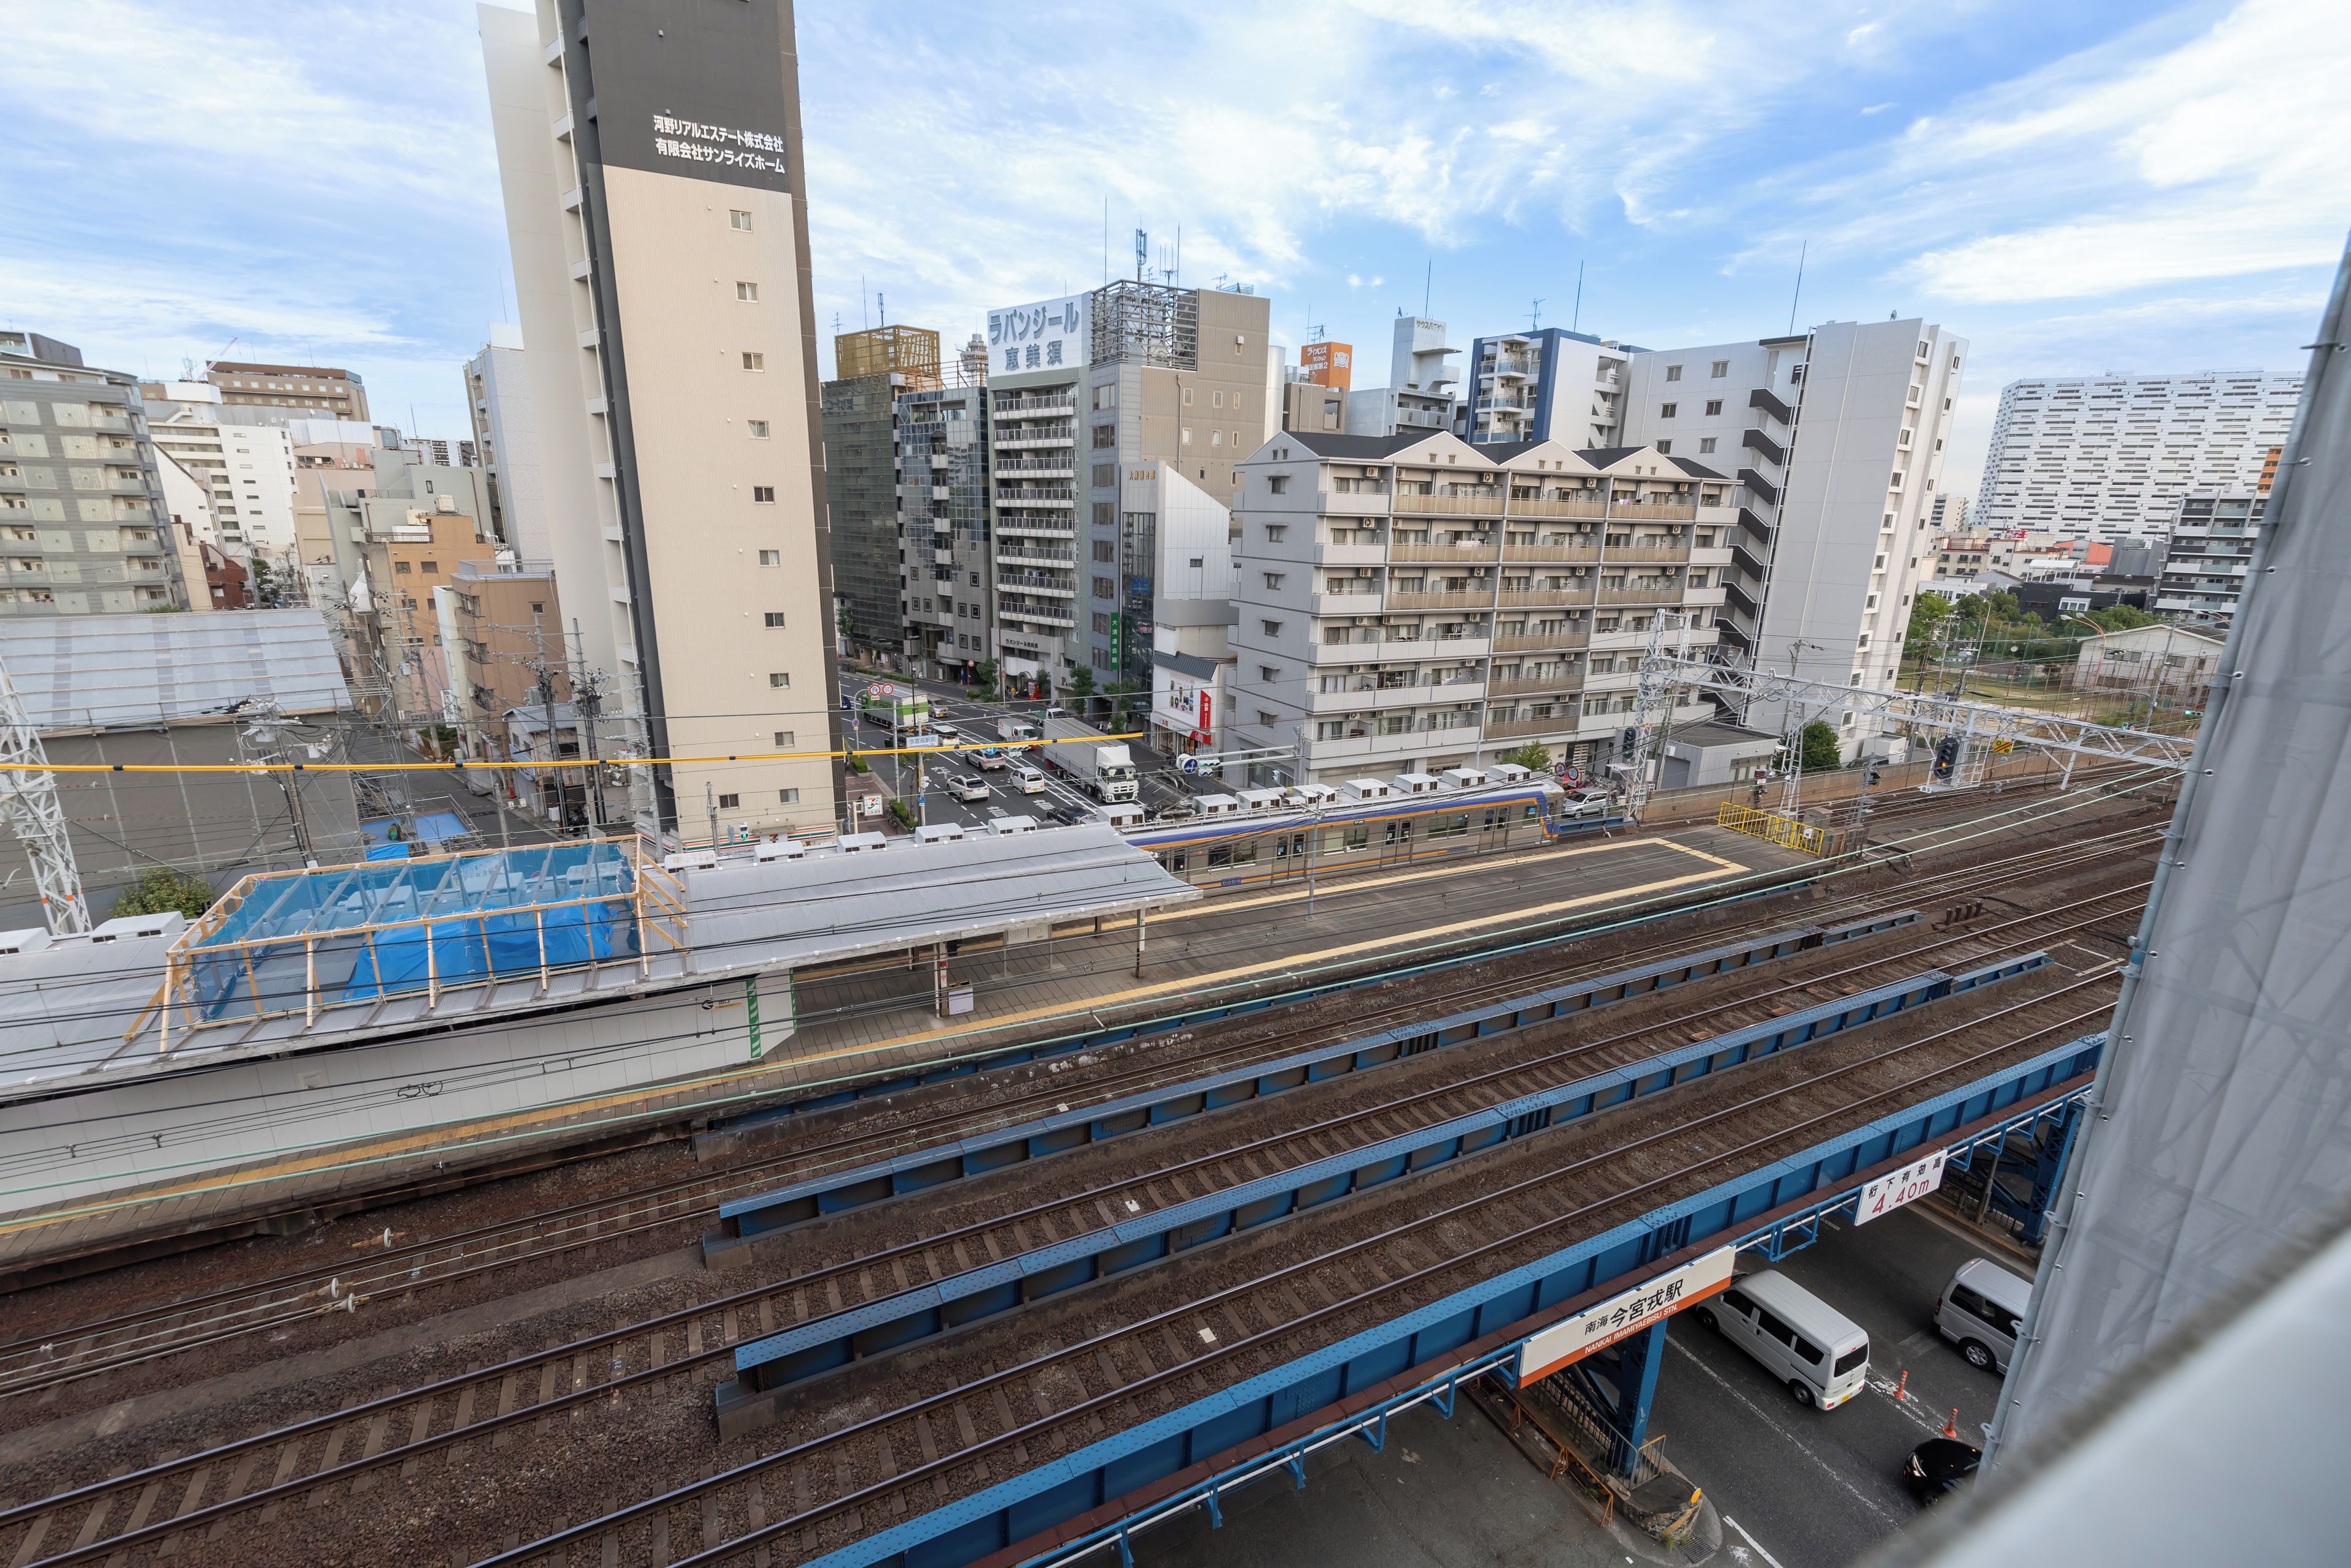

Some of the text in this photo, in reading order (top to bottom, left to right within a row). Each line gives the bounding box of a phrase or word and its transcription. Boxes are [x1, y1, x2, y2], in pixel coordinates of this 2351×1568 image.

[653, 114, 784, 153] 河野リアルエステート株式会社
[655, 137, 786, 174] 有限会社サンライズホーム
[989, 302, 1079, 346] ラパンジール
[1005, 340, 1063, 371] 恵美須
[1307, 345, 1327, 356] ライオンズ
[1868, 1156, 1943, 1199] 桁下有効高
[1872, 1179, 1930, 1214] 4.40m
[1584, 1278, 1684, 1336] 南海 今宮戎駅
[1584, 1337, 1612, 1354] NANKAI
[1613, 1314, 1662, 1341] IMAMIYAEBISU
